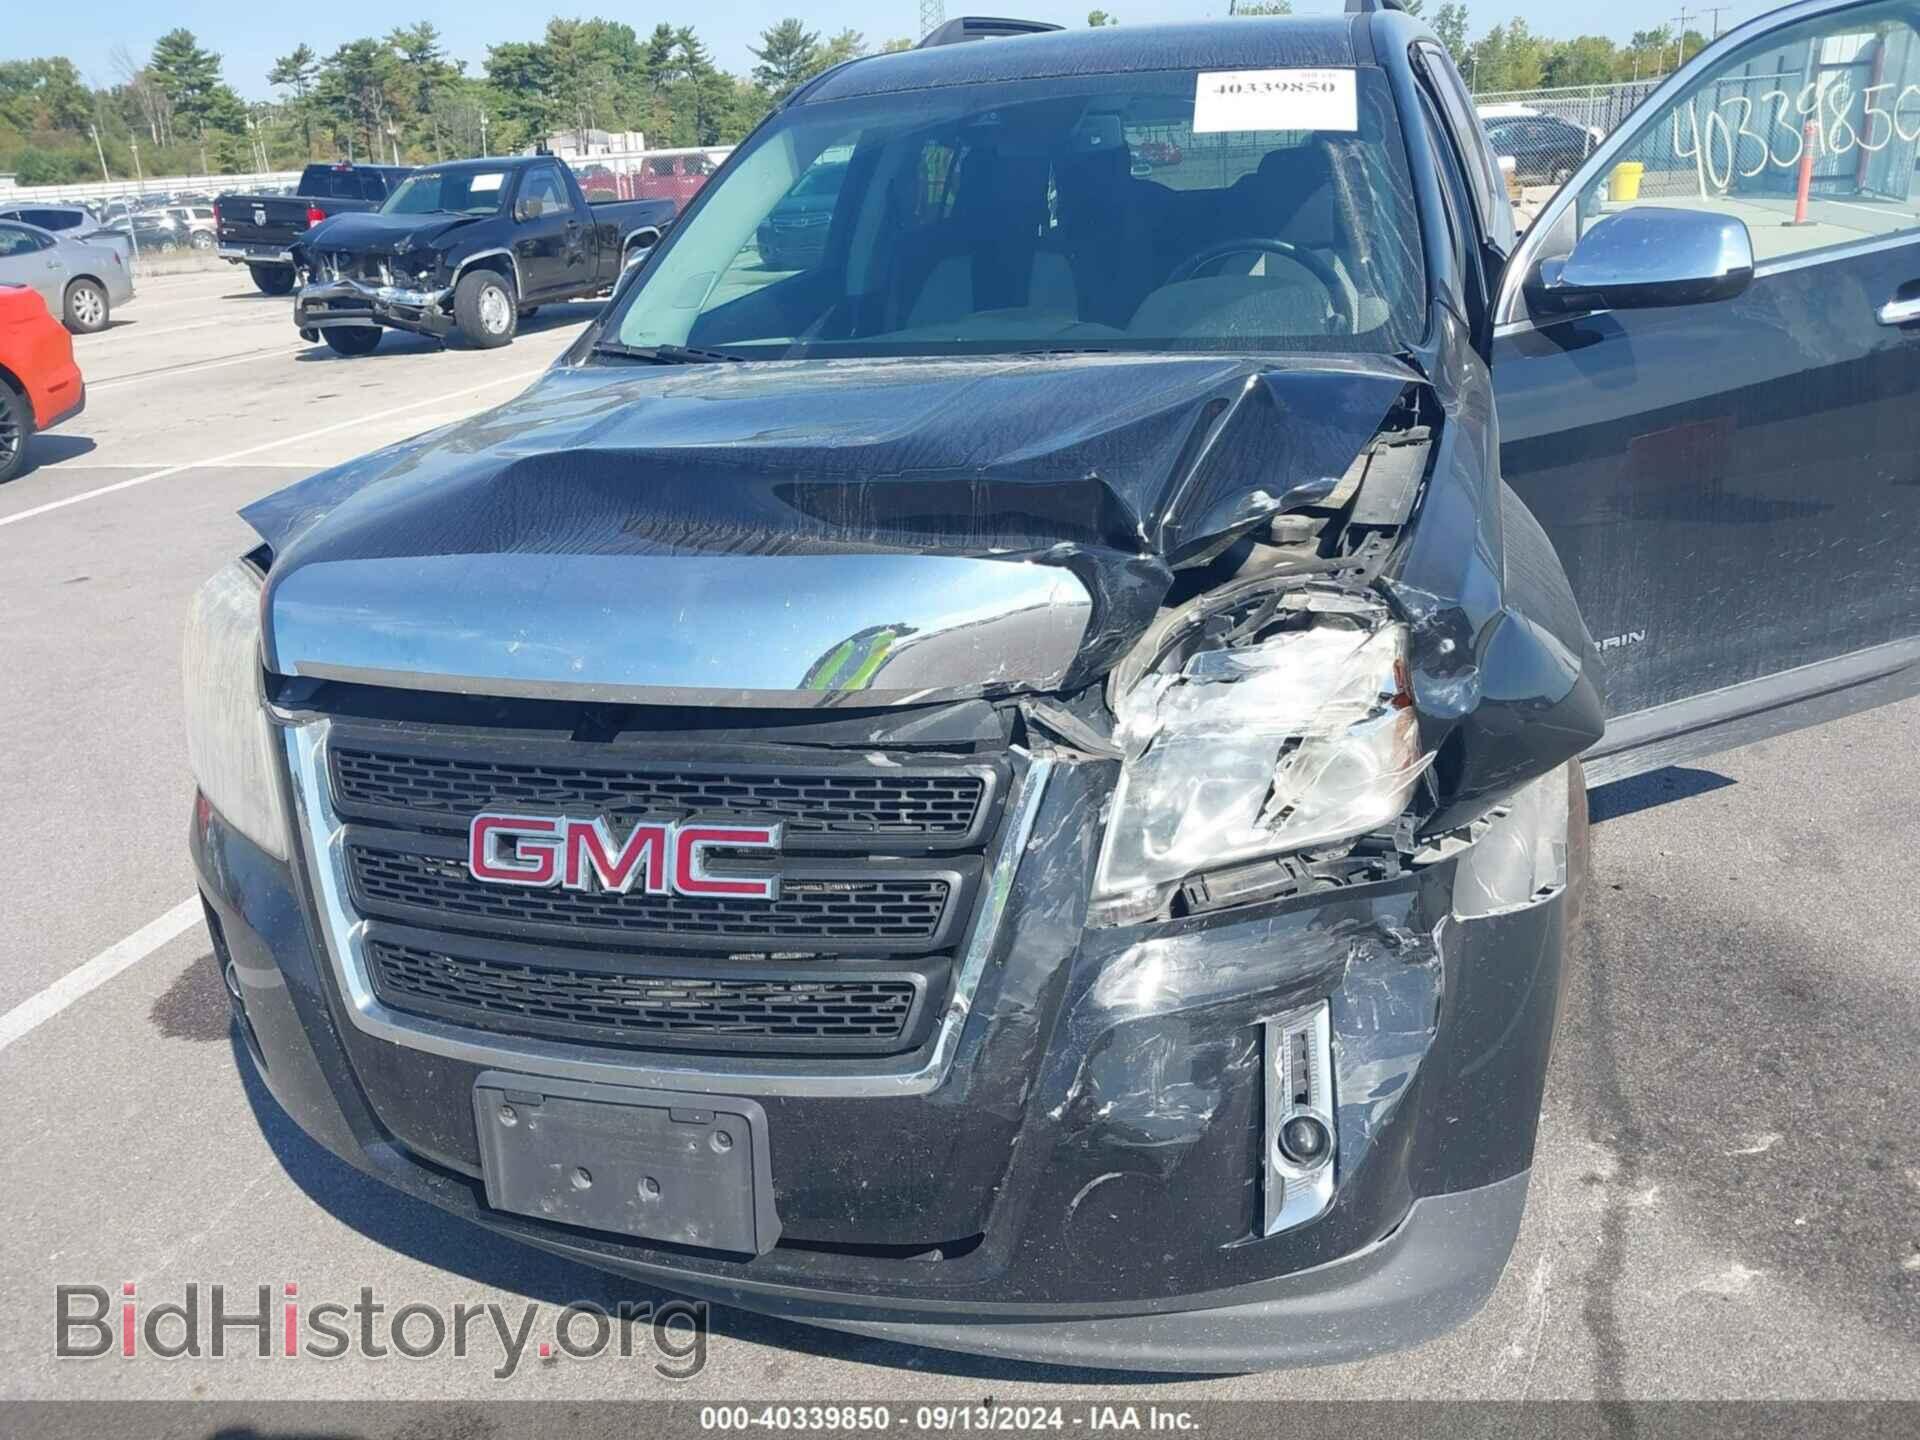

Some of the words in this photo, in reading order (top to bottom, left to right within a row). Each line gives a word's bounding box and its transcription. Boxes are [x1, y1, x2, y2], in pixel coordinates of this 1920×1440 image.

[1212, 81, 1336, 95] 40339850
[1672, 70, 1920, 202] 40339850
[469, 812, 783, 900] GMC
